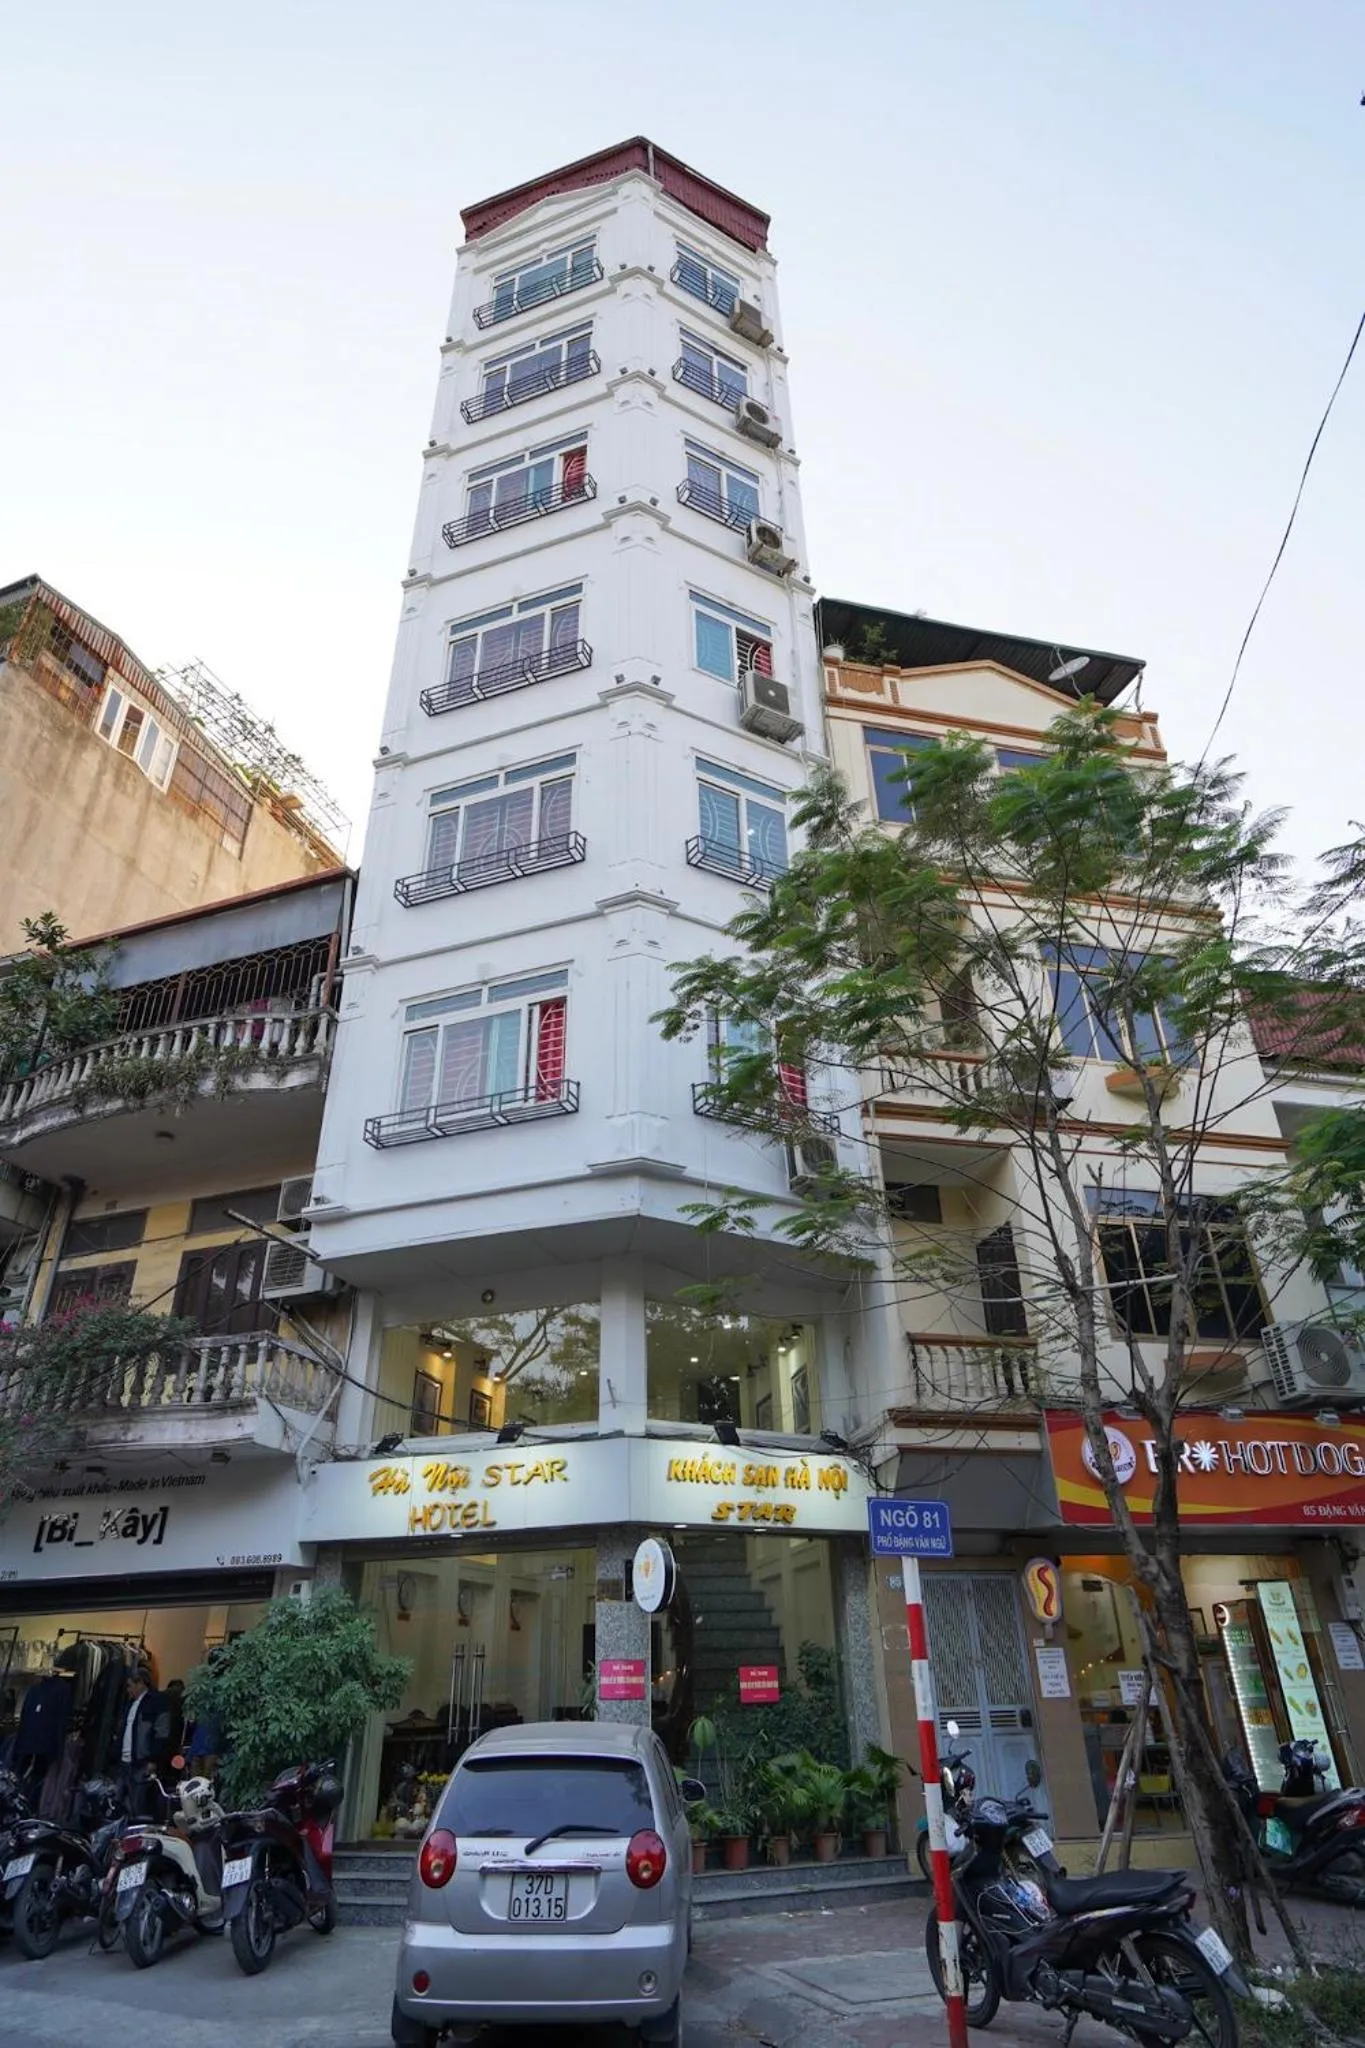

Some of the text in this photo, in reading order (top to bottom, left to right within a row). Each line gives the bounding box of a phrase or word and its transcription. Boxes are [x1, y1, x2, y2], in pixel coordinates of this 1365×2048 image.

[481, 1457, 569, 1488] STAR
[667, 1452, 849, 1499] KHÁCH SẠN HÀ NỘI
[409, 1500, 497, 1533] HOTEL
[711, 1502, 797, 1525] STAR
[880, 1505, 940, 1528] NGÕ 81
[525, 1875, 553, 1895] 37D
[512, 1898, 563, 1918] 013.15
